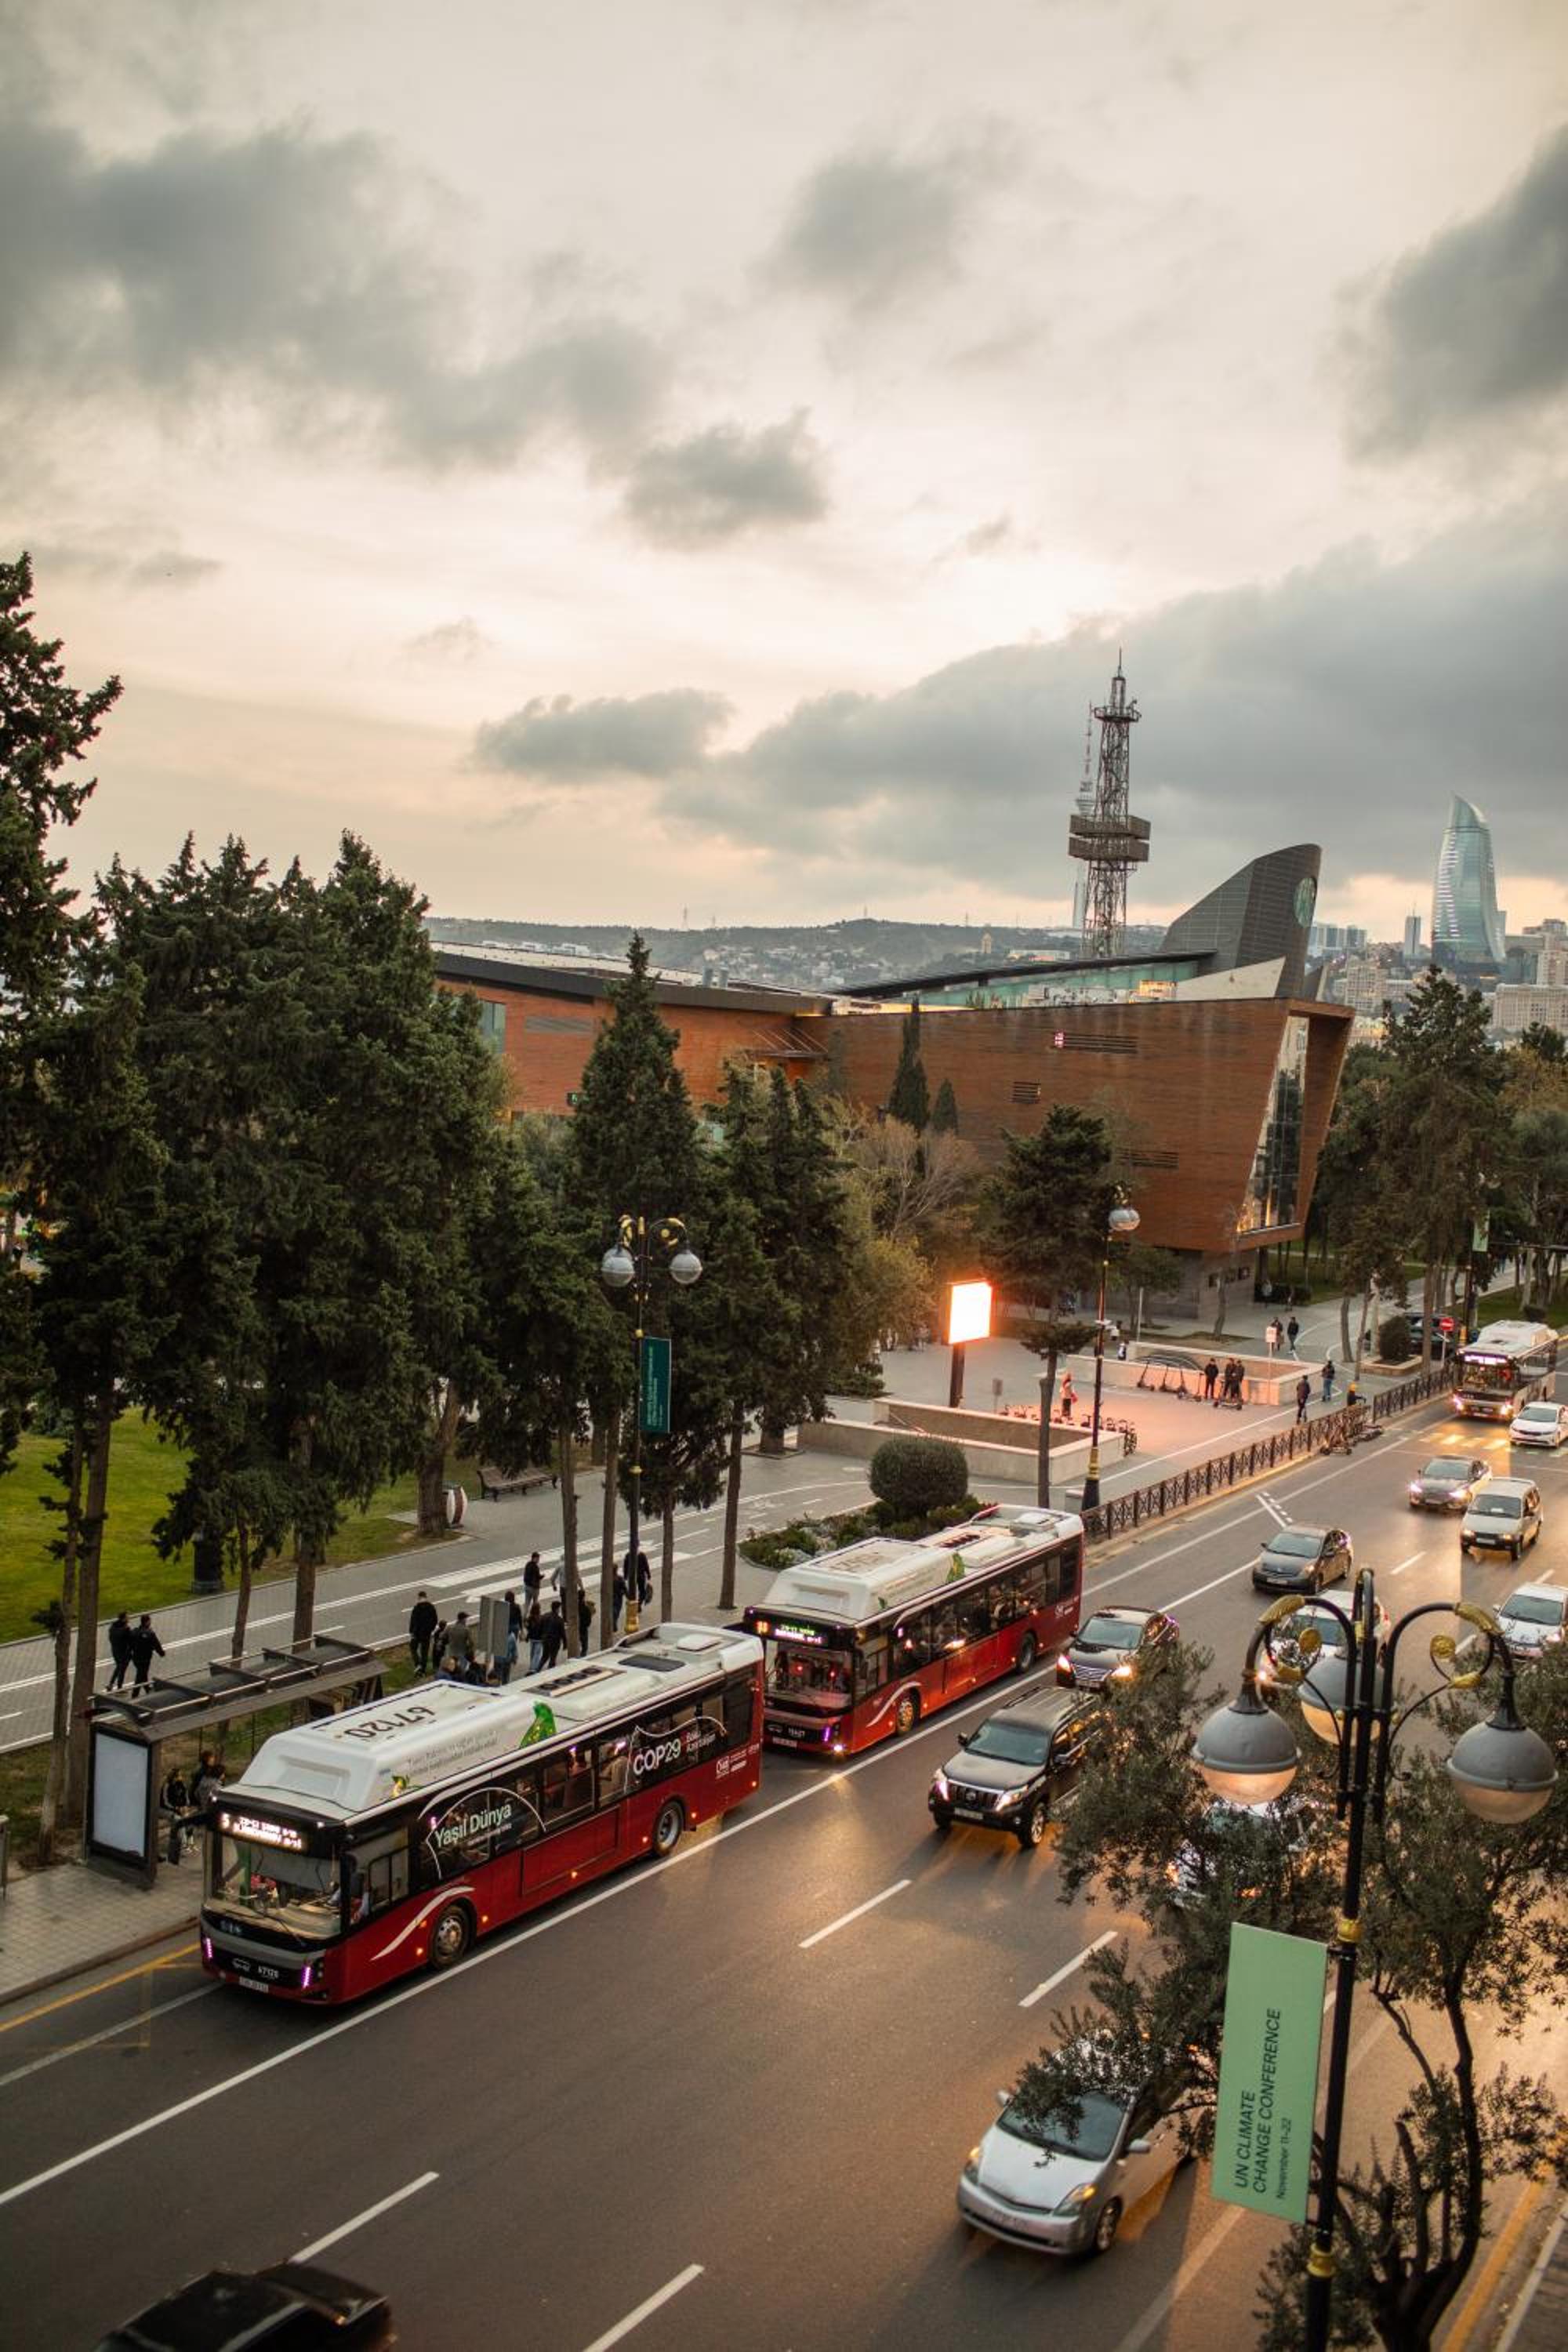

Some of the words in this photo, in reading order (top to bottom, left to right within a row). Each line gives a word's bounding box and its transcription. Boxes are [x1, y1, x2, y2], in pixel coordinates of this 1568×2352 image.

[633, 1738, 681, 1775] COP29
[434, 1817, 467, 1847] Yaşıl
[470, 1804, 512, 1833] Dünya
[1258, 2008, 1280, 2120] CONFERENCE
[1237, 2090, 1255, 2159] CLIMATE
[1235, 2164, 1249, 2187] UN
[1253, 2123, 1271, 2193] CHANGE
